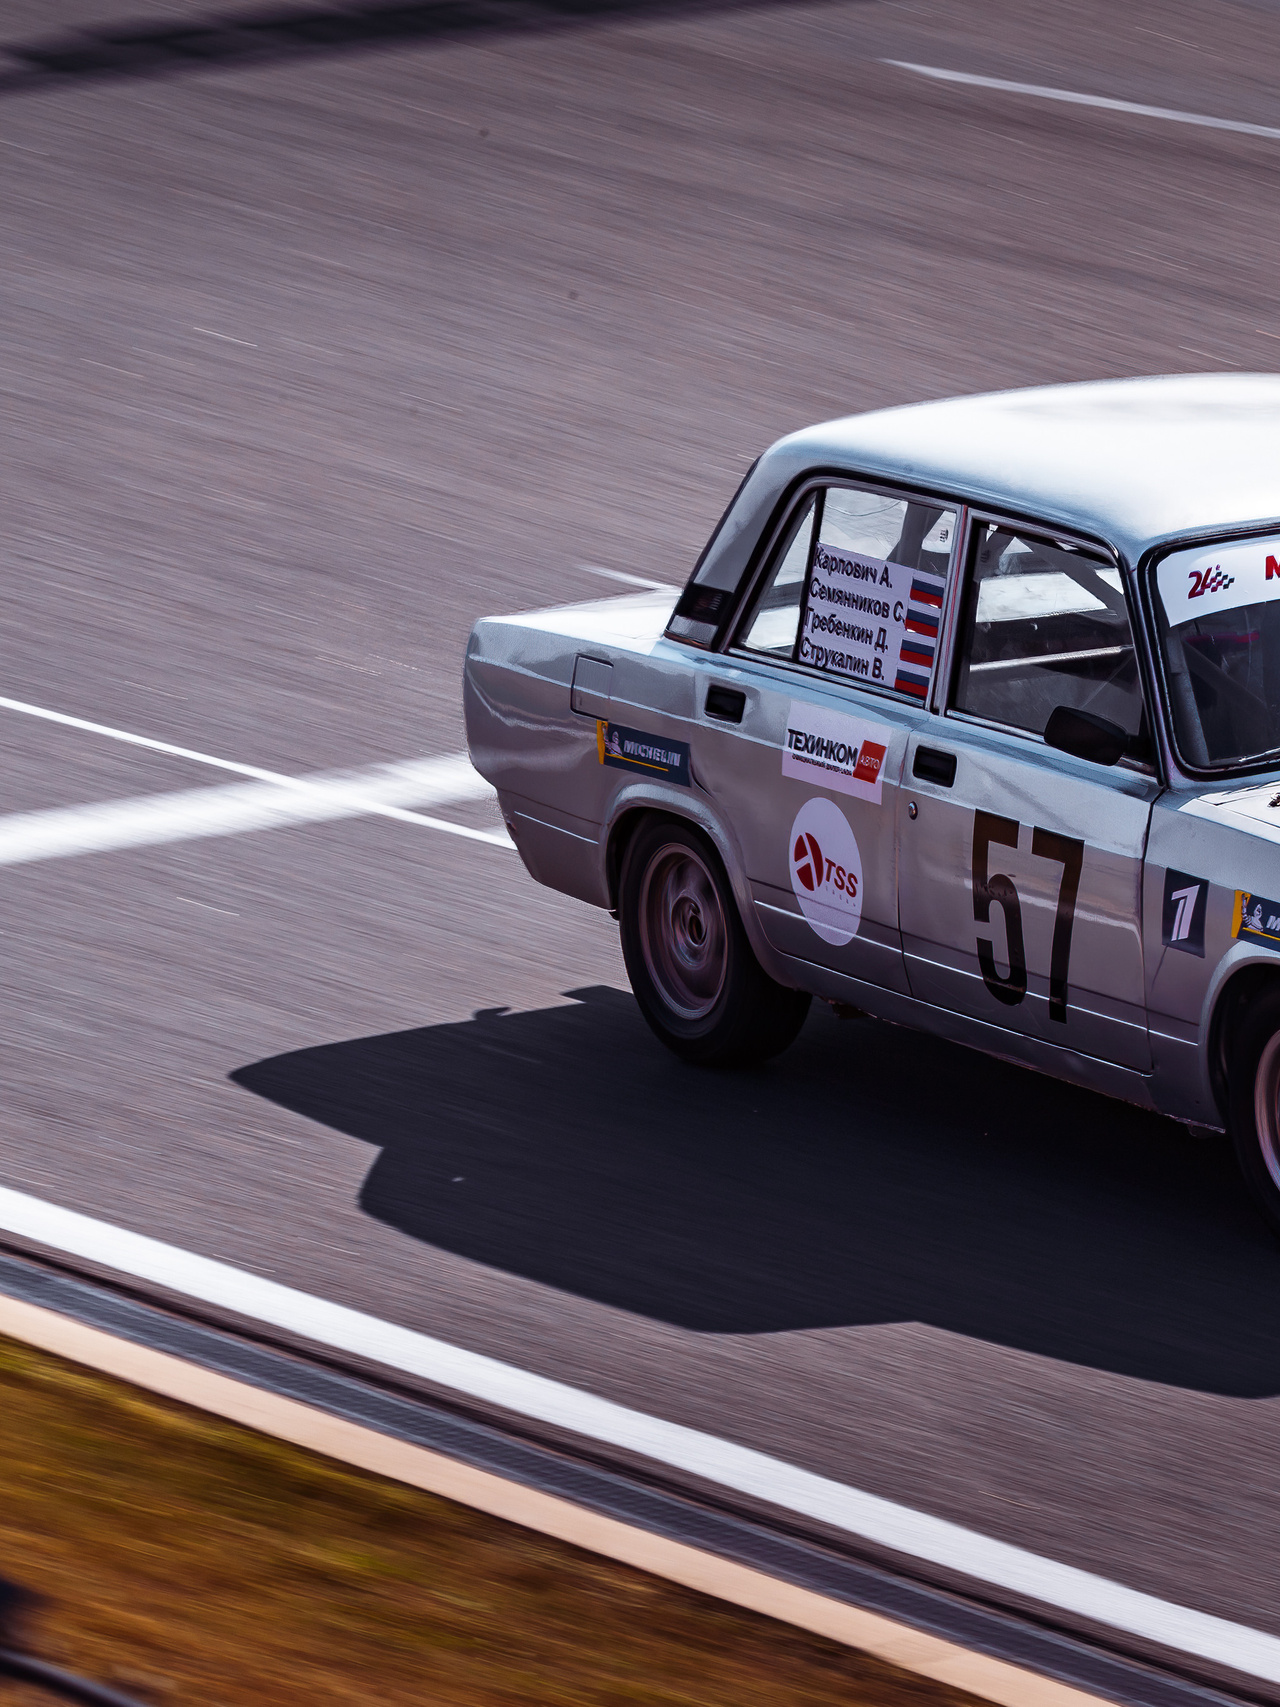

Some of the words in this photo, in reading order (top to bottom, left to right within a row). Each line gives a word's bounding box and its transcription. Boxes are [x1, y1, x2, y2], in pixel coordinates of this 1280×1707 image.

[814, 548, 878, 585] Карпович
[809, 577, 890, 618] Семянников
[804, 606, 873, 645] Гребенкин
[874, 627, 888, 653] Д.
[872, 657, 884, 680] В.
[624, 740, 681, 767] MICHELIN
[788, 728, 858, 768] ТЕХИНКОМ
[860, 755, 880, 770] АВТО
[825, 857, 858, 898] TSS
[972, 808, 1085, 1024] 57
